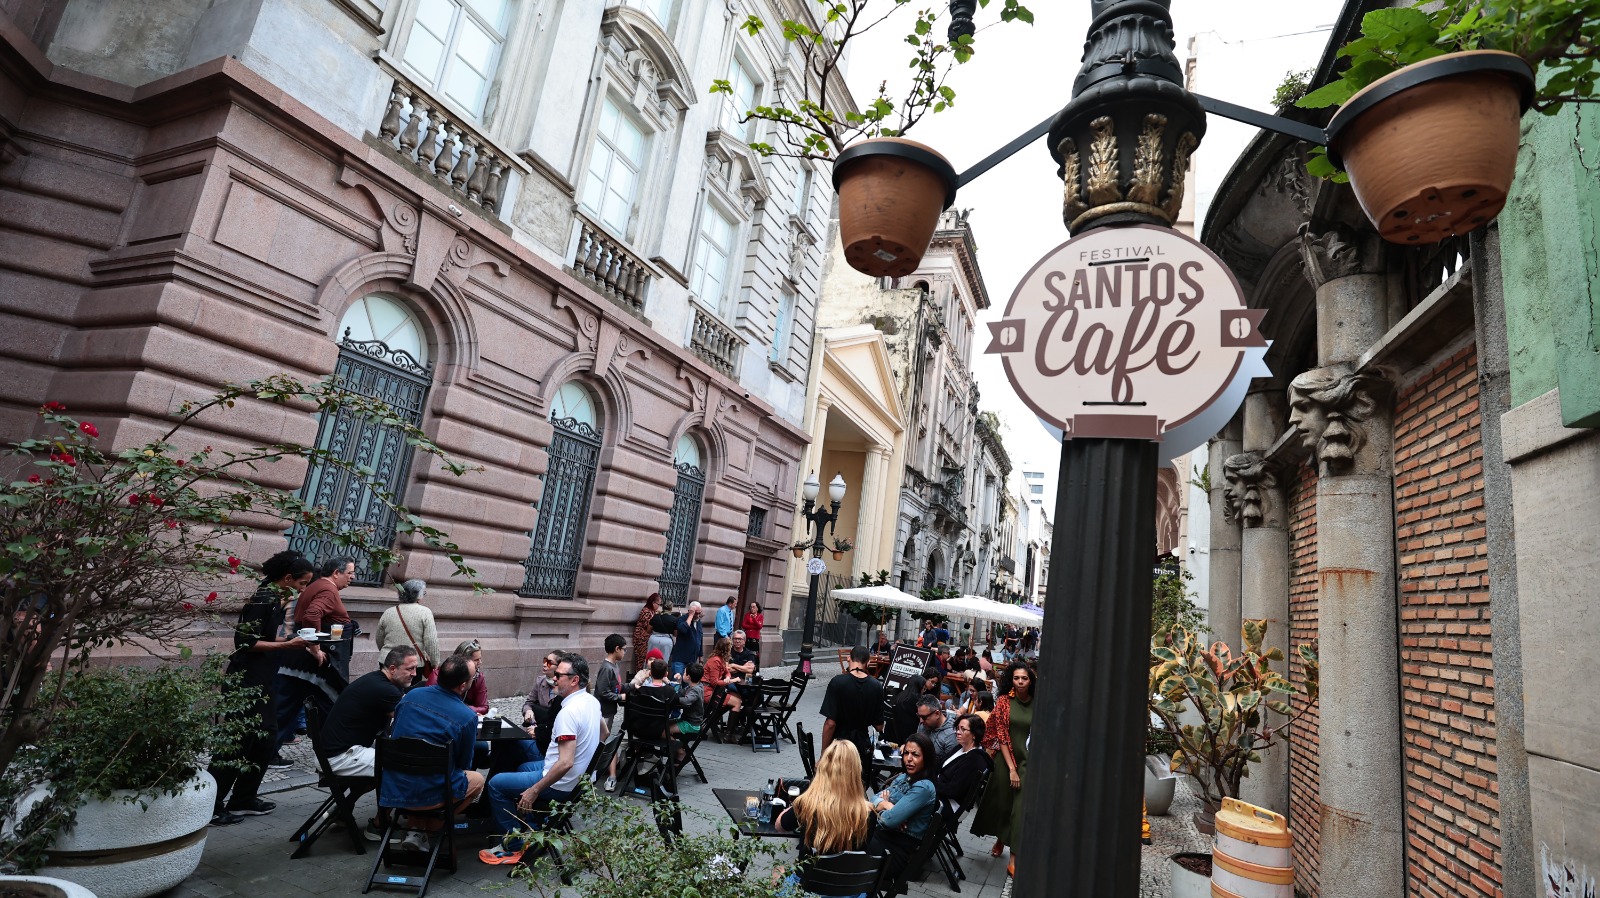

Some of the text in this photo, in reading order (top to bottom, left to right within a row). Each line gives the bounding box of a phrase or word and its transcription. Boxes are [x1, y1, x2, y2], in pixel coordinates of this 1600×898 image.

[1080, 245, 1165, 262] FESTIVAL
[1042, 260, 1204, 312] SANTOS
[1035, 296, 1201, 405] Café
